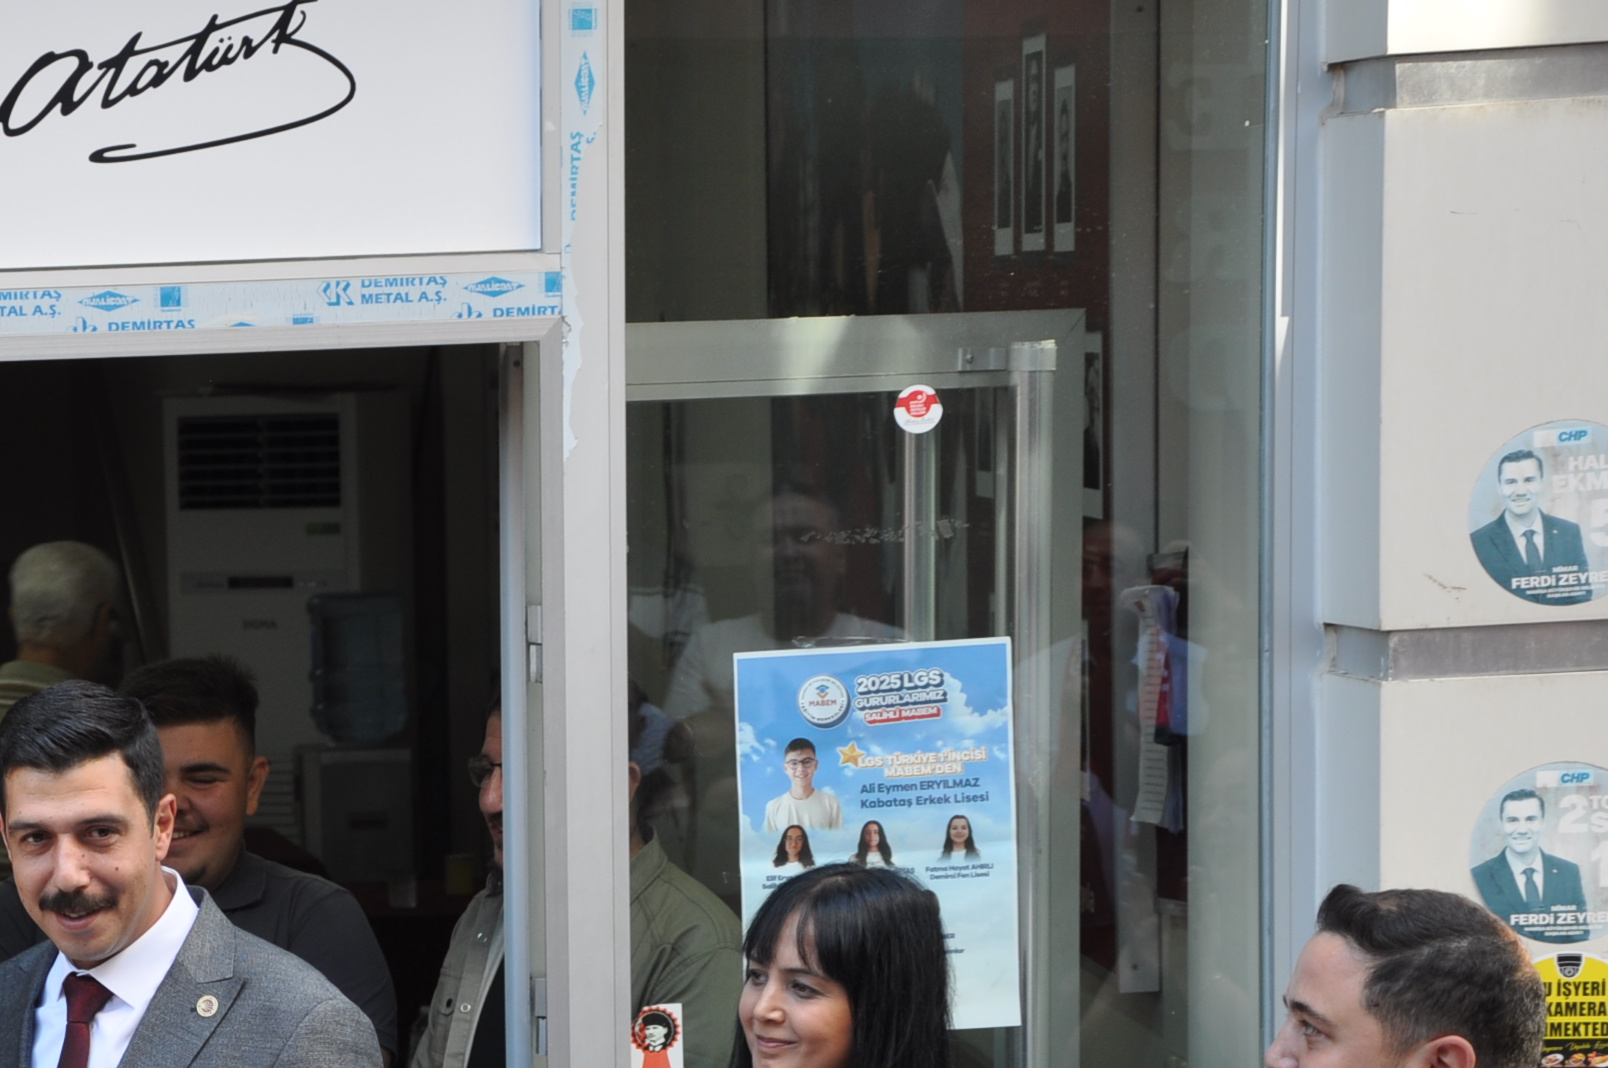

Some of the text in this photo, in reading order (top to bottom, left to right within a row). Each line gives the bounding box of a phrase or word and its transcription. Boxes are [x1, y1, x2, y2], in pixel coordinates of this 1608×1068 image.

[360, 291, 447, 304] METAL A.Ş.
[33, 304, 61, 318] A.Ş.
[1558, 430, 1588, 442] CHP
[857, 676, 901, 692] 2025
[904, 670, 941, 687] LGS
[855, 690, 944, 708] GURURLARIMIZ
[865, 707, 938, 722] SALİHLİ MABEM
[860, 778, 980, 795] Ali Eymen ERYILMAZ
[1560, 773, 1590, 784] CHP
[860, 791, 989, 809] Kabataş Erkek Lisesi
[1558, 794, 1589, 833] 2
[1557, 978, 1606, 999] İŞYERİ
[1548, 1001, 1607, 1017] KAMERA
[1545, 1022, 1608, 1038] MEKTED
